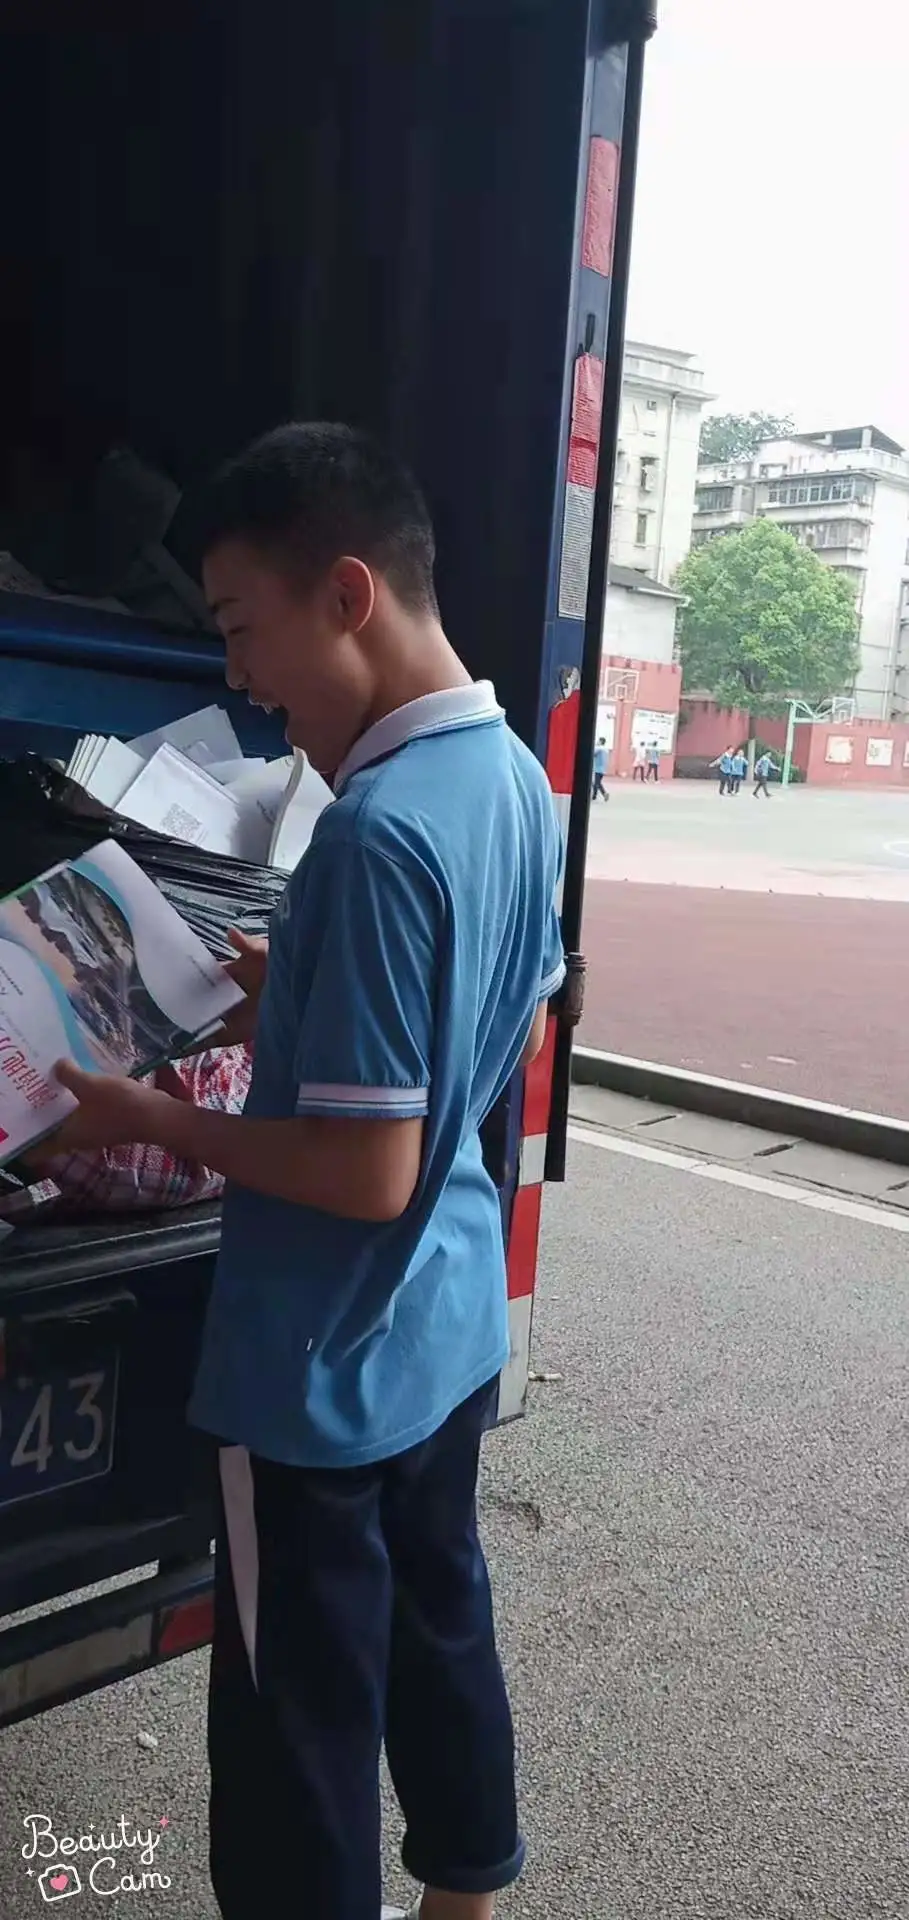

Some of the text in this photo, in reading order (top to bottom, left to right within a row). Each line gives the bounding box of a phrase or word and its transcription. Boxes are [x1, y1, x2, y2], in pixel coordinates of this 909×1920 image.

[0, 1033, 58, 1109] 湖南地方
[0, 1371, 106, 1475] 43
